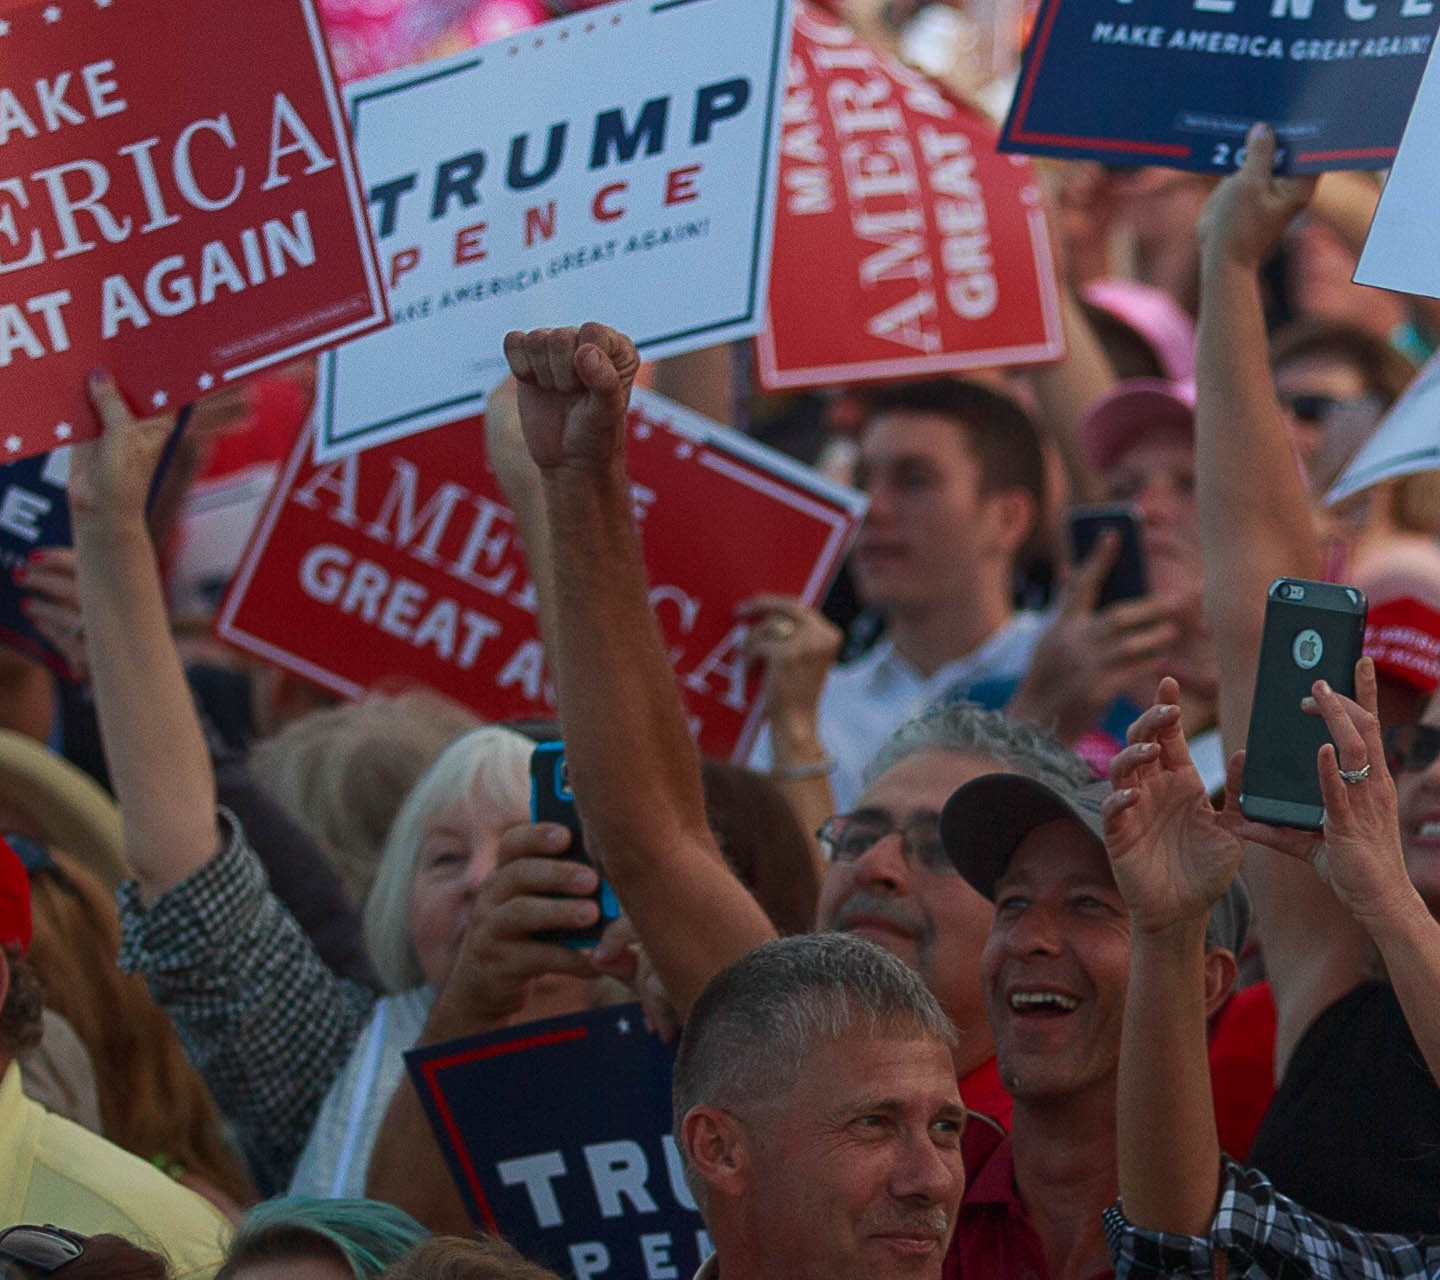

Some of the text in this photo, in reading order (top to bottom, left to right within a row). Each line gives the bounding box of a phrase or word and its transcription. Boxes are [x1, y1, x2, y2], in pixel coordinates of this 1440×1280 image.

[1092, 21, 1165, 49] MAKE
[1167, 29, 1285, 61] AMERICA
[1290, 35, 1360, 62] GREAT
[369, 76, 753, 240] TRUMP
[99, 209, 317, 340] AGAIN
[390, 163, 704, 290] PENCE
[394, 295, 434, 324] AKE
[439, 269, 542, 312] AMERICA
[548, 240, 619, 279] GREAT
[298, 544, 503, 670] GREAT
